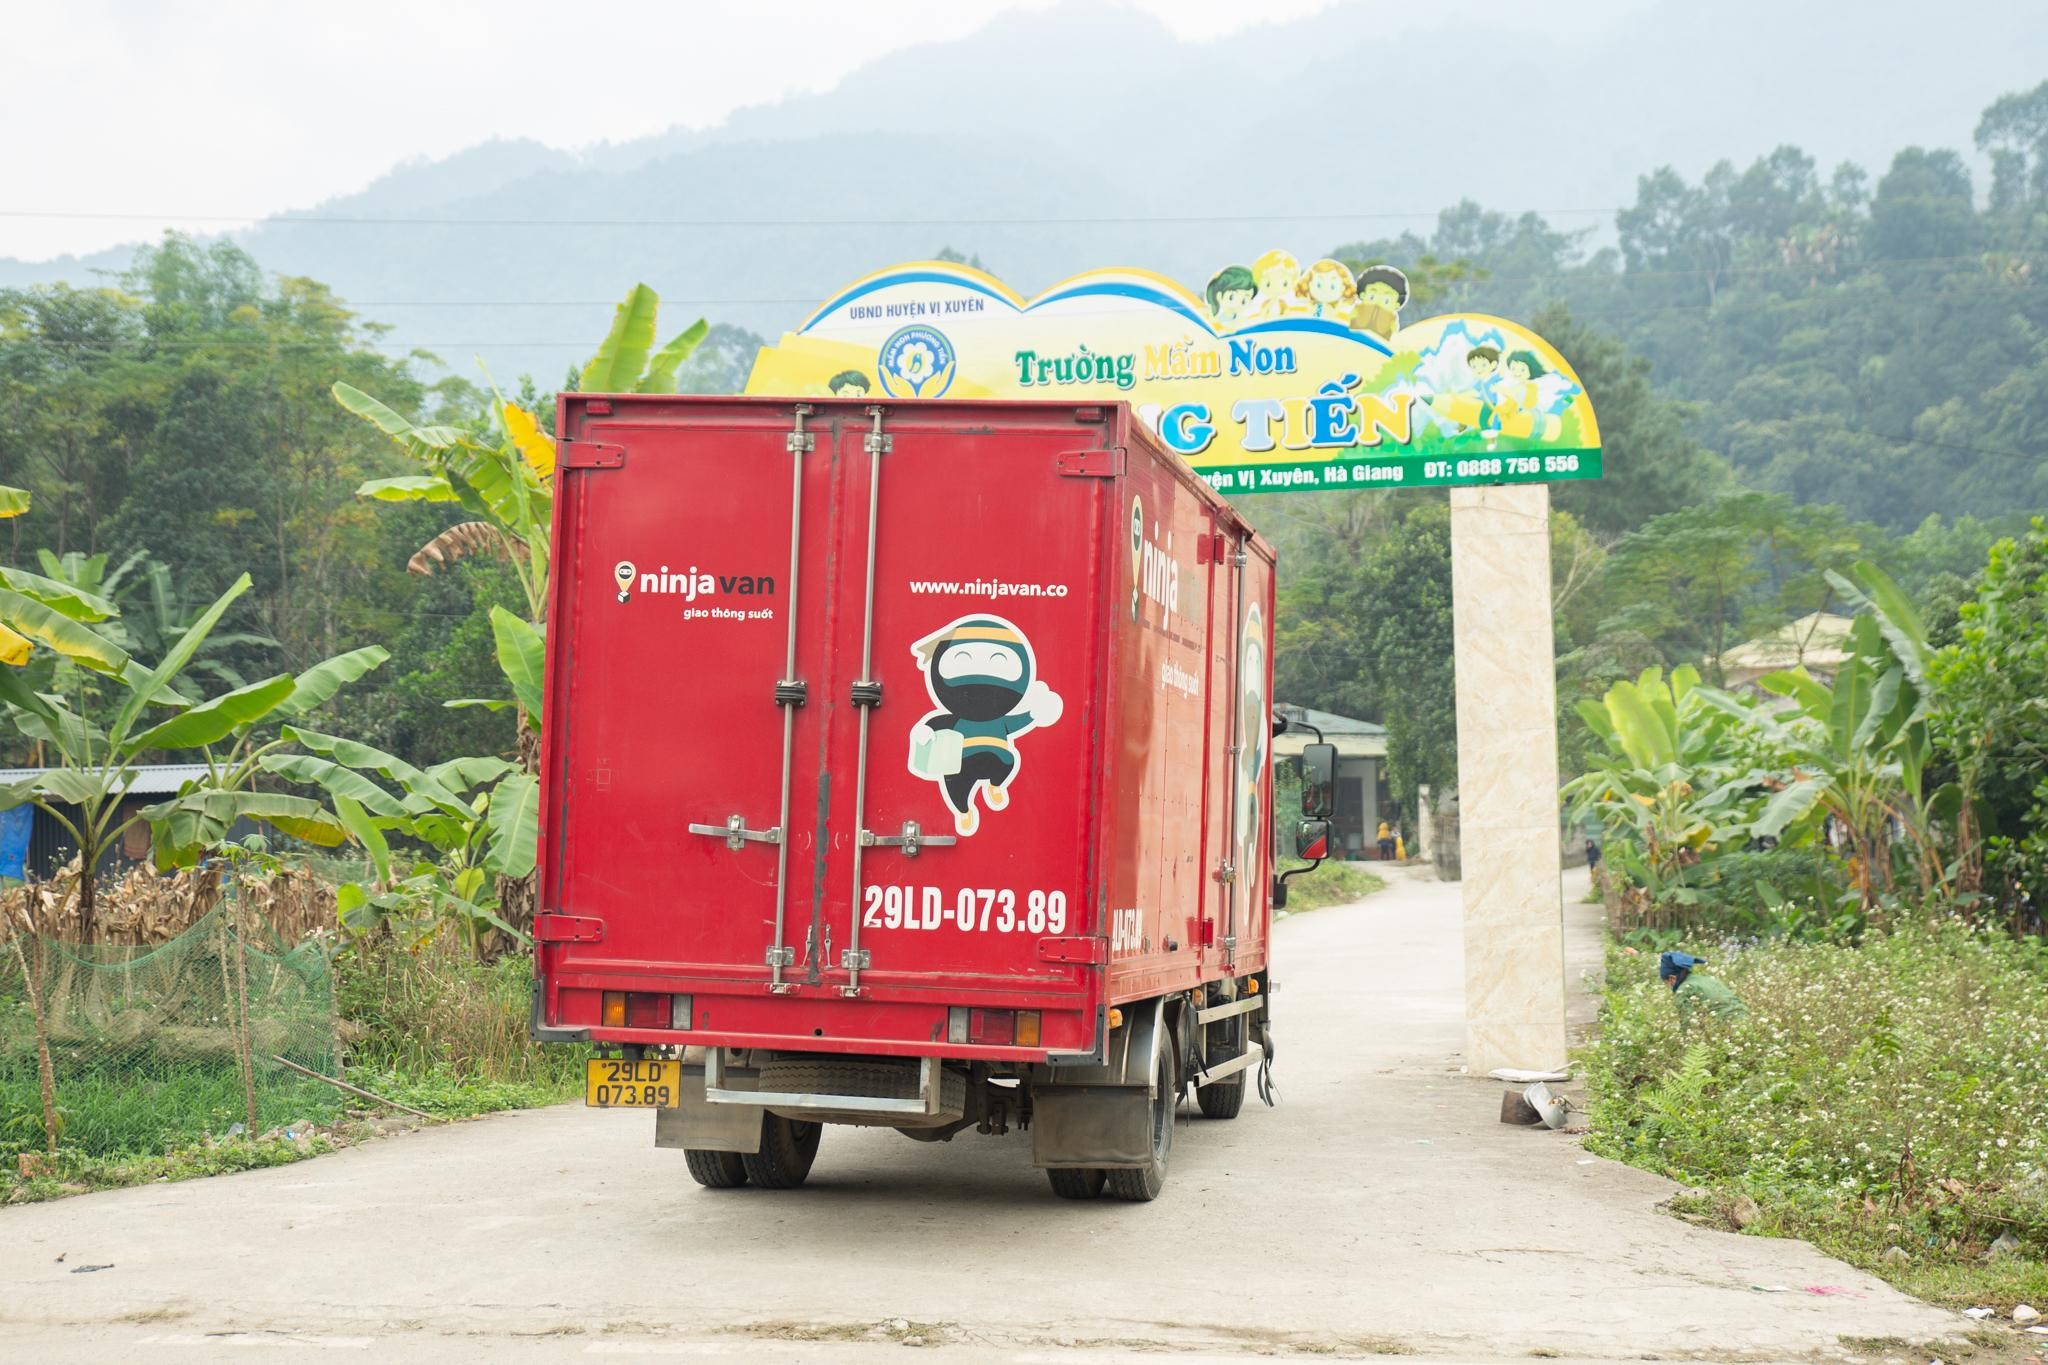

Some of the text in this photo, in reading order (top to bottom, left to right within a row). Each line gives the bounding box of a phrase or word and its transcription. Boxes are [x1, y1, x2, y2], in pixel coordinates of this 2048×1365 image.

[850, 296, 984, 320] UBND HUYỆN VỊ XUYÊN
[1015, 335, 1298, 390] Trường Mầm Non
[1231, 373, 1417, 451] TIẾN
[1237, 469, 1255, 489] Vị
[1260, 468, 1320, 487] Xuyên,
[1323, 465, 1348, 482] Hà
[1352, 464, 1404, 481] Giang
[1424, 454, 1579, 478] ĐT: 0888 756 556
[1143, 520, 1179, 631] ninja
[909, 578, 1069, 600] www.ninjavan.co
[683, 607, 774, 621] giao thông suốt
[863, 885, 1067, 935] 29LD-073.89
[607, 1062, 661, 1082] 29LD
[597, 1084, 670, 1106] 073.89
